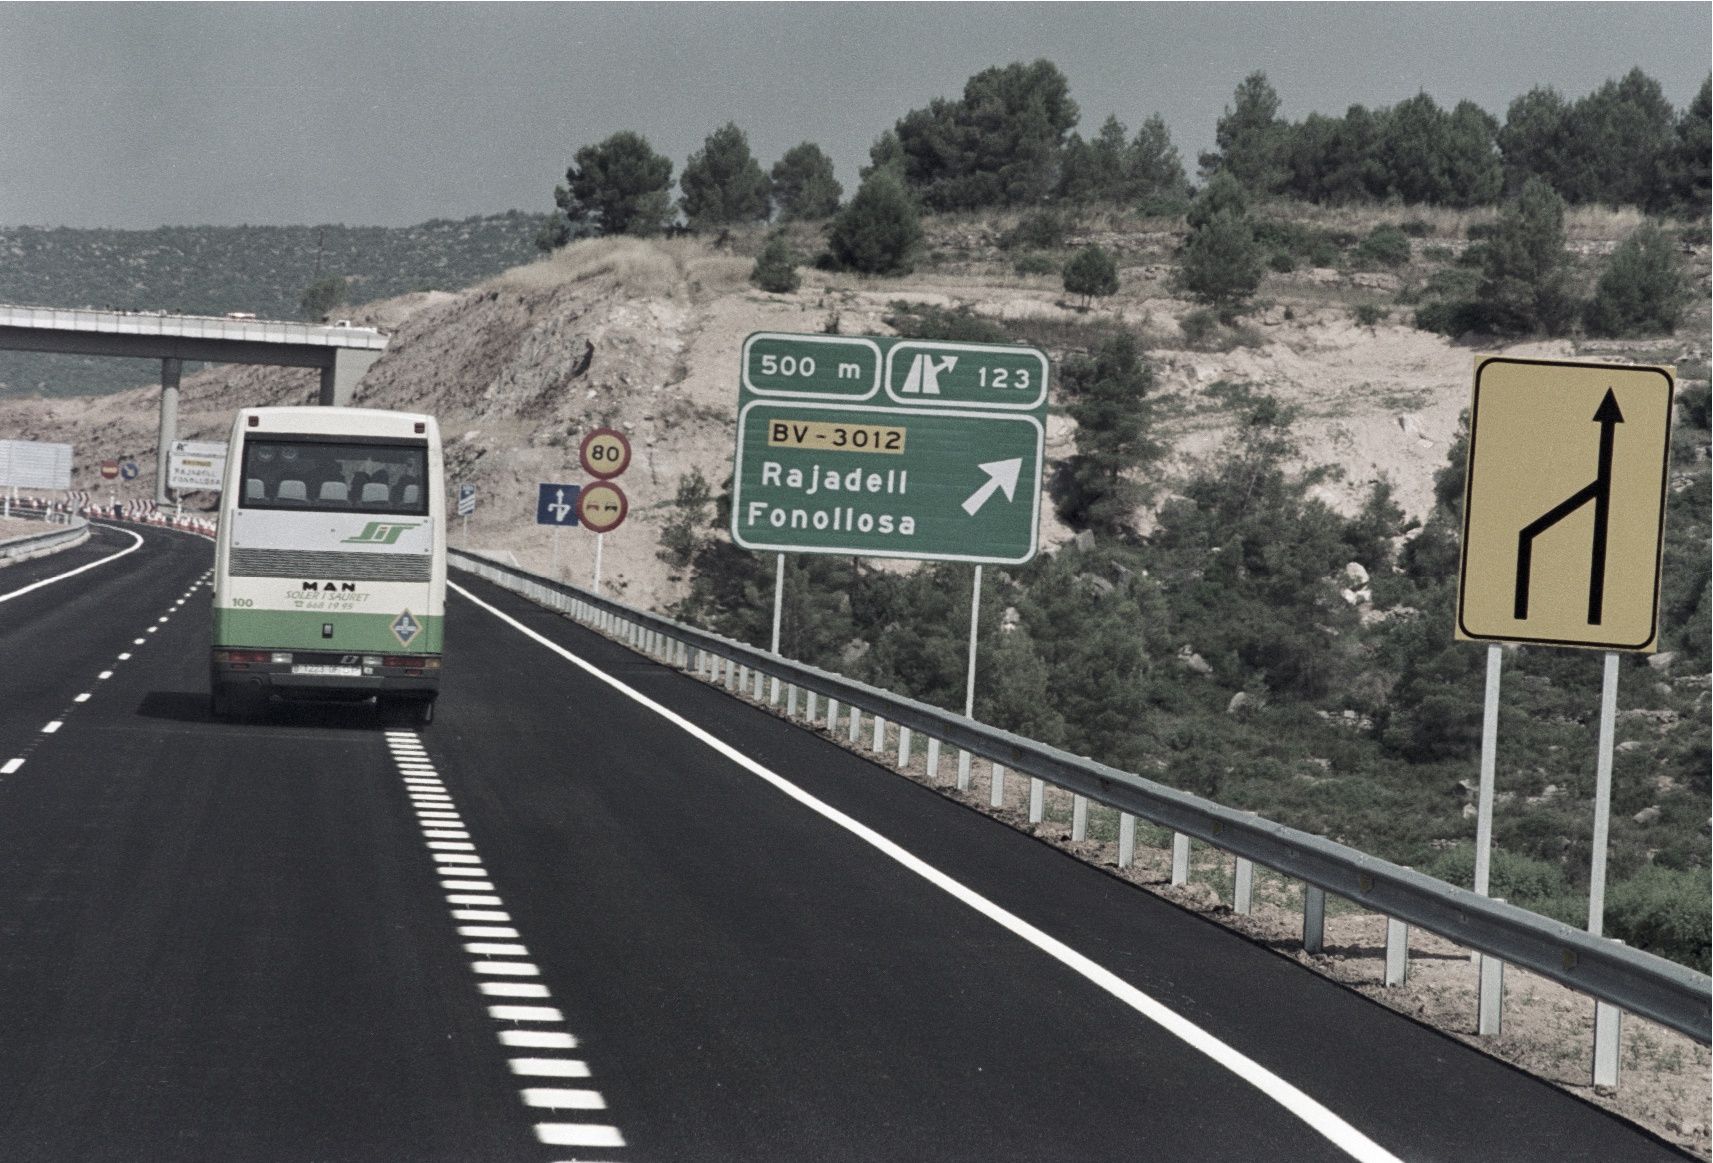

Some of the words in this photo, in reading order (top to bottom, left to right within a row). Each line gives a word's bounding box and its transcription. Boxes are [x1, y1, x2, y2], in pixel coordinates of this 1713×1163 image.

[760, 354, 816, 377] 500
[838, 362, 861, 379] m
[978, 366, 1030, 389] 123
[591, 444, 620, 462] 80
[762, 461, 907, 495] Rajadell
[748, 501, 916, 536] Fonollosa
[285, 590, 320, 600] SOLER
[328, 592, 371, 602] SAURET
[302, 581, 356, 592] MAN
[232, 597, 253, 608] 100
